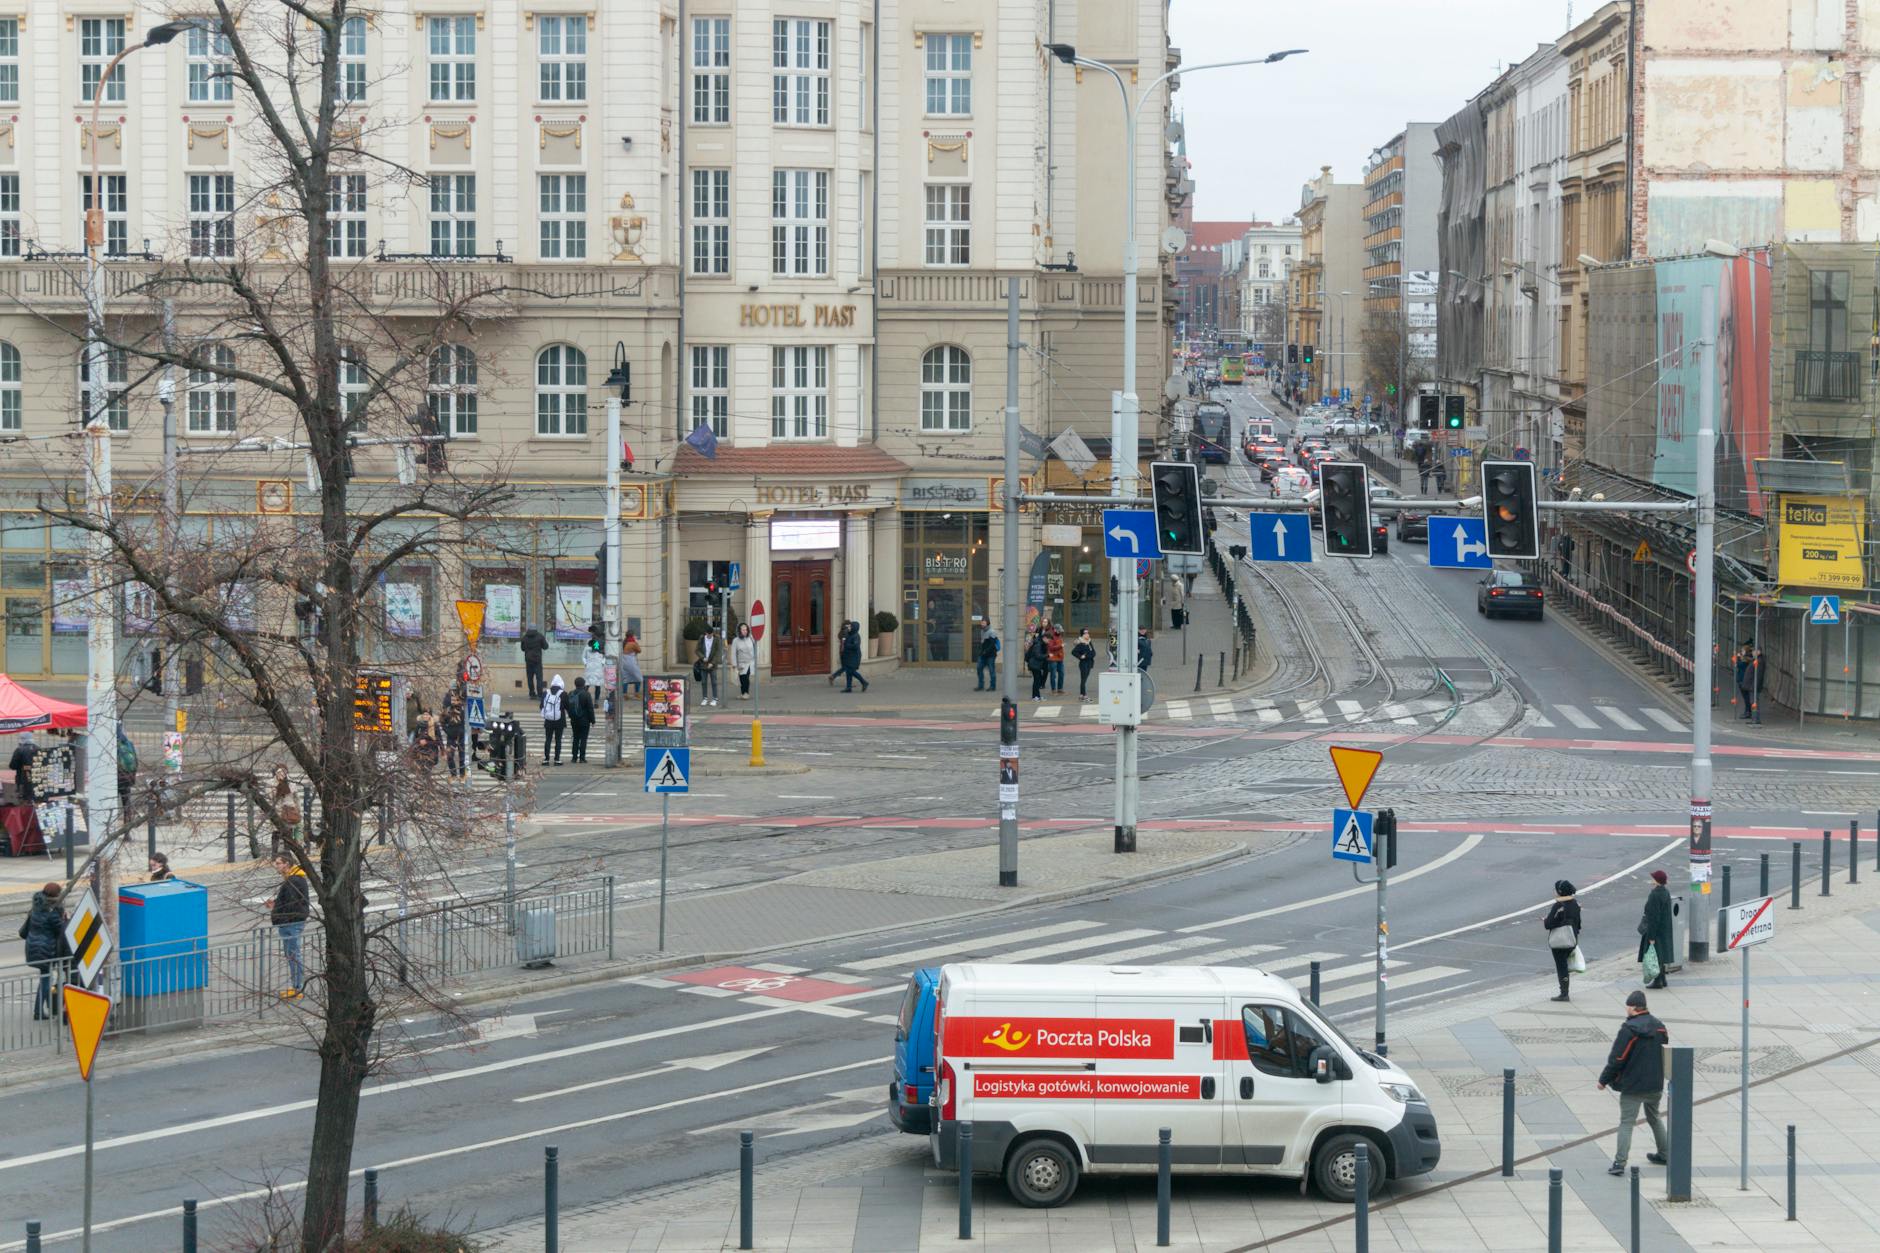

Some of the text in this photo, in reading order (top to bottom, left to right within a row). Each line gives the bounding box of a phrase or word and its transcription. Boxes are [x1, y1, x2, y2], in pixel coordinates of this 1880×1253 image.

[740, 304, 857, 328] HOTEL PIAST
[757, 484, 870, 504] HOTEL PIAST
[1805, 550, 1819, 559] 200
[1037, 1029, 1152, 1047] Poczta Polska
[975, 1079, 1190, 1096] Logistyka gotówki, konwojowanie
